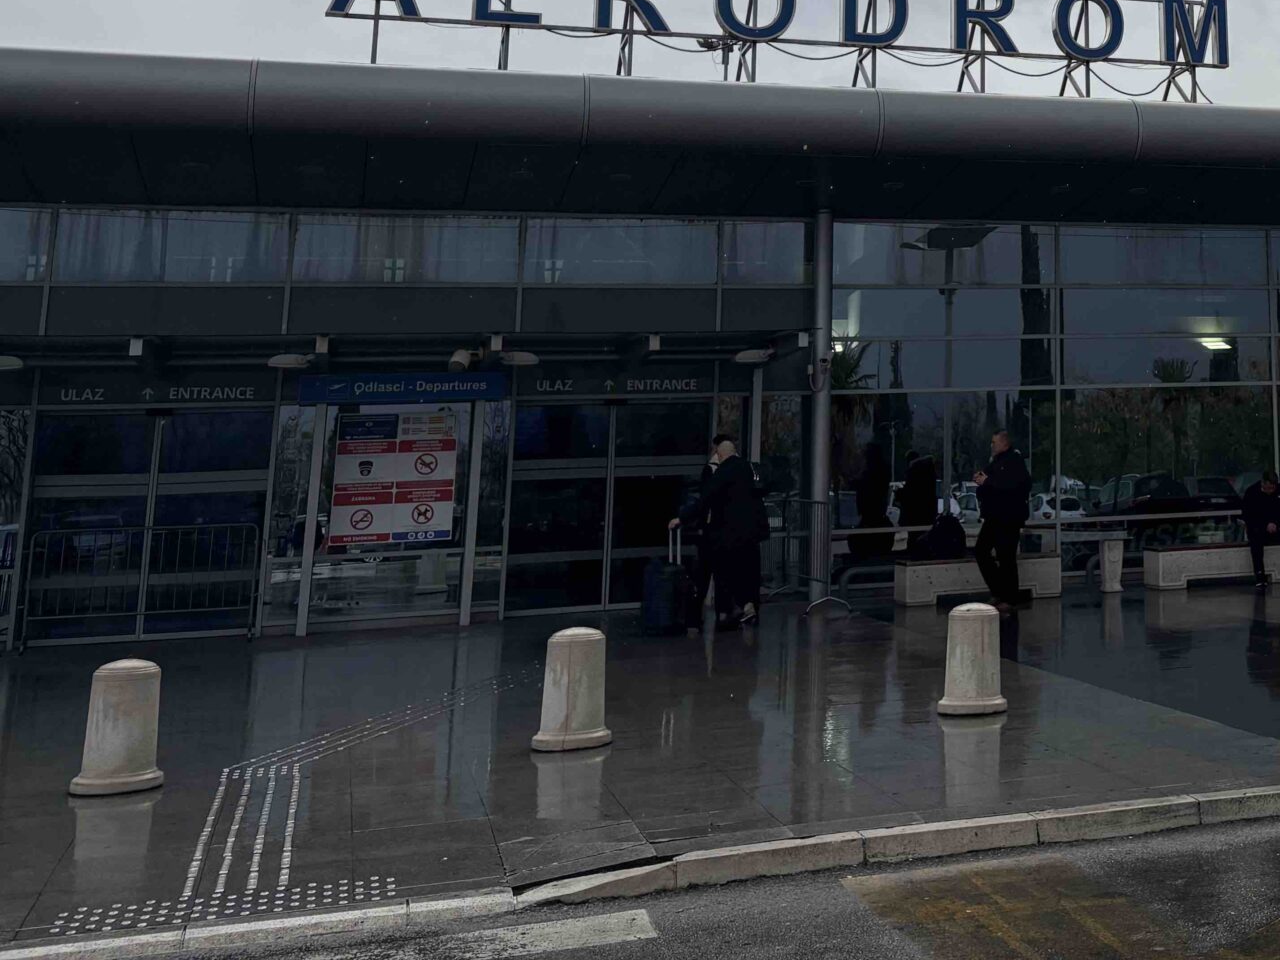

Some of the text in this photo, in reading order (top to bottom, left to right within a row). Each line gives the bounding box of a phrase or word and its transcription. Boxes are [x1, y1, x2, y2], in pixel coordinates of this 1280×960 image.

[60, 385, 256, 401] ULAZ ENTRANCE
[416, 380, 488, 393] Departures
[536, 377, 698, 393] ULAZ ENTRANCE
